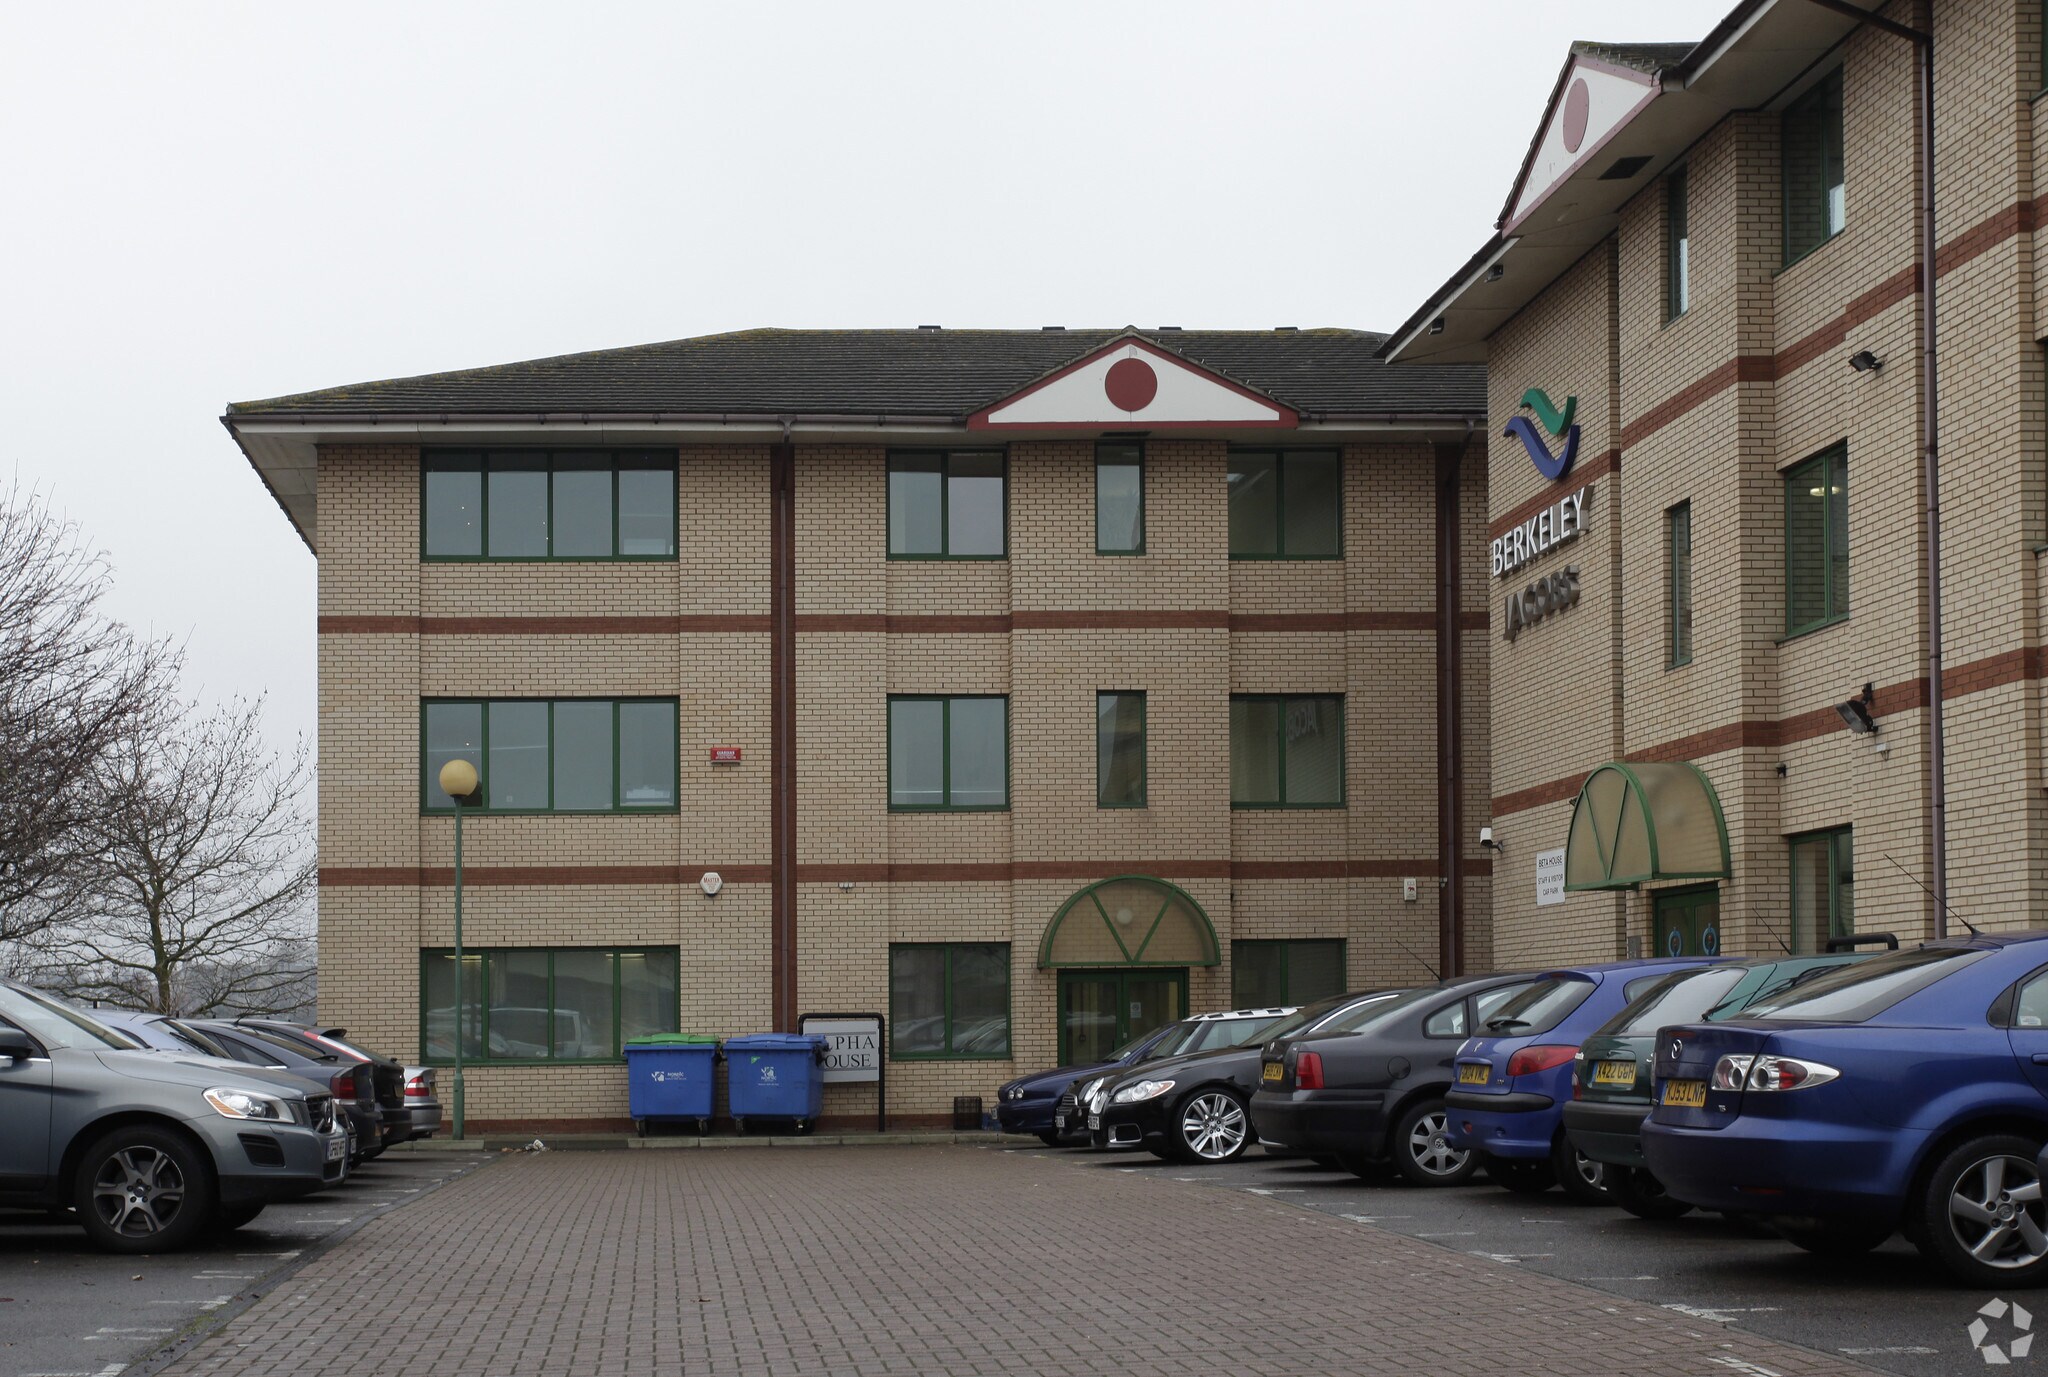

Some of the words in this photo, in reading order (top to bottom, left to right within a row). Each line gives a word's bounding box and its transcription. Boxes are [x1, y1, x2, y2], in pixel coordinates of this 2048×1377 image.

[1493, 487, 1586, 577] BERKELEY
[1503, 564, 1580, 641] JACOBS
[1539, 859, 1548, 867] BETA
[1549, 855, 1562, 865] HOUSE
[829, 1035, 875, 1050] PHA
[824, 1053, 871, 1069] OUSE
[1597, 1061, 1617, 1080] X422
[1666, 1081, 1686, 1101] KJ53
[1686, 1082, 1706, 1103] LNR
